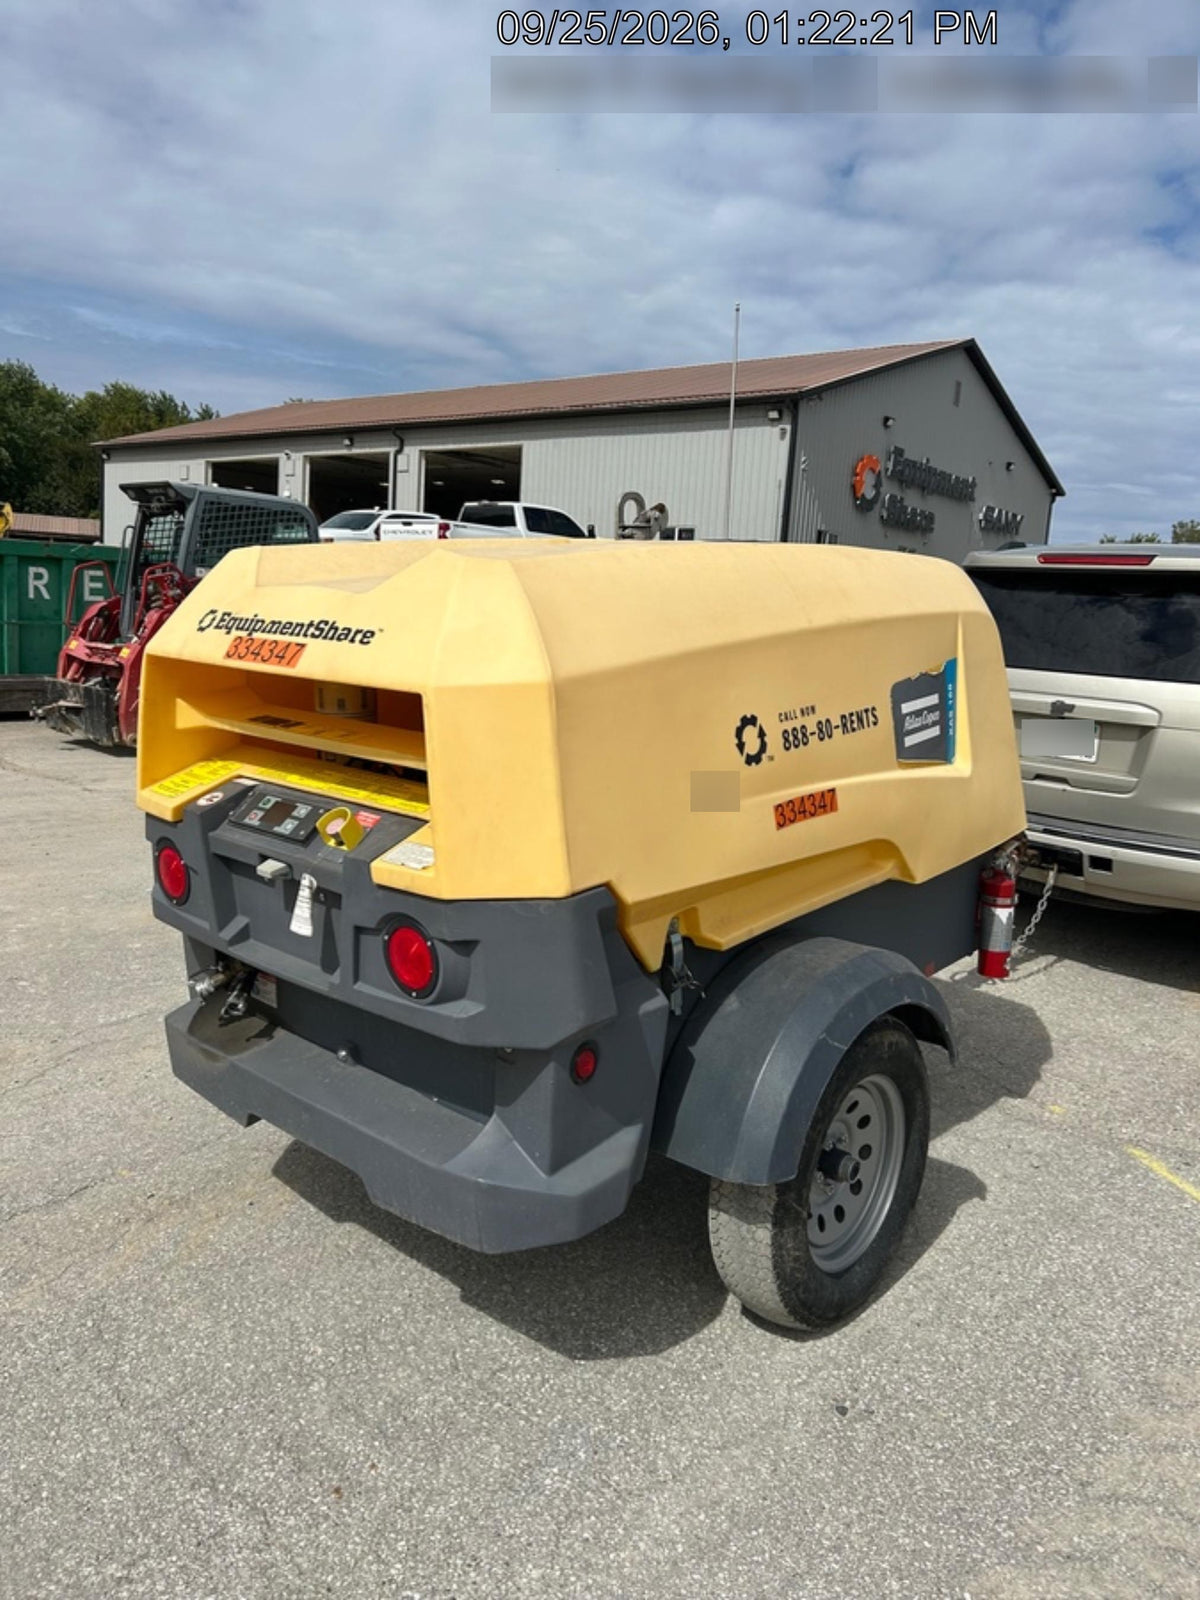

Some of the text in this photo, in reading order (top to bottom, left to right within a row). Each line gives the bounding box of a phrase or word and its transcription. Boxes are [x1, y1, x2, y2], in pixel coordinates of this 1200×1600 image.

[214, 612, 376, 646] EquipmentShare
[225, 635, 307, 667] 334347
[778, 710, 798, 723] CALL
[782, 706, 879, 751] 888-80-RENTS
[775, 789, 837, 829] 334347
